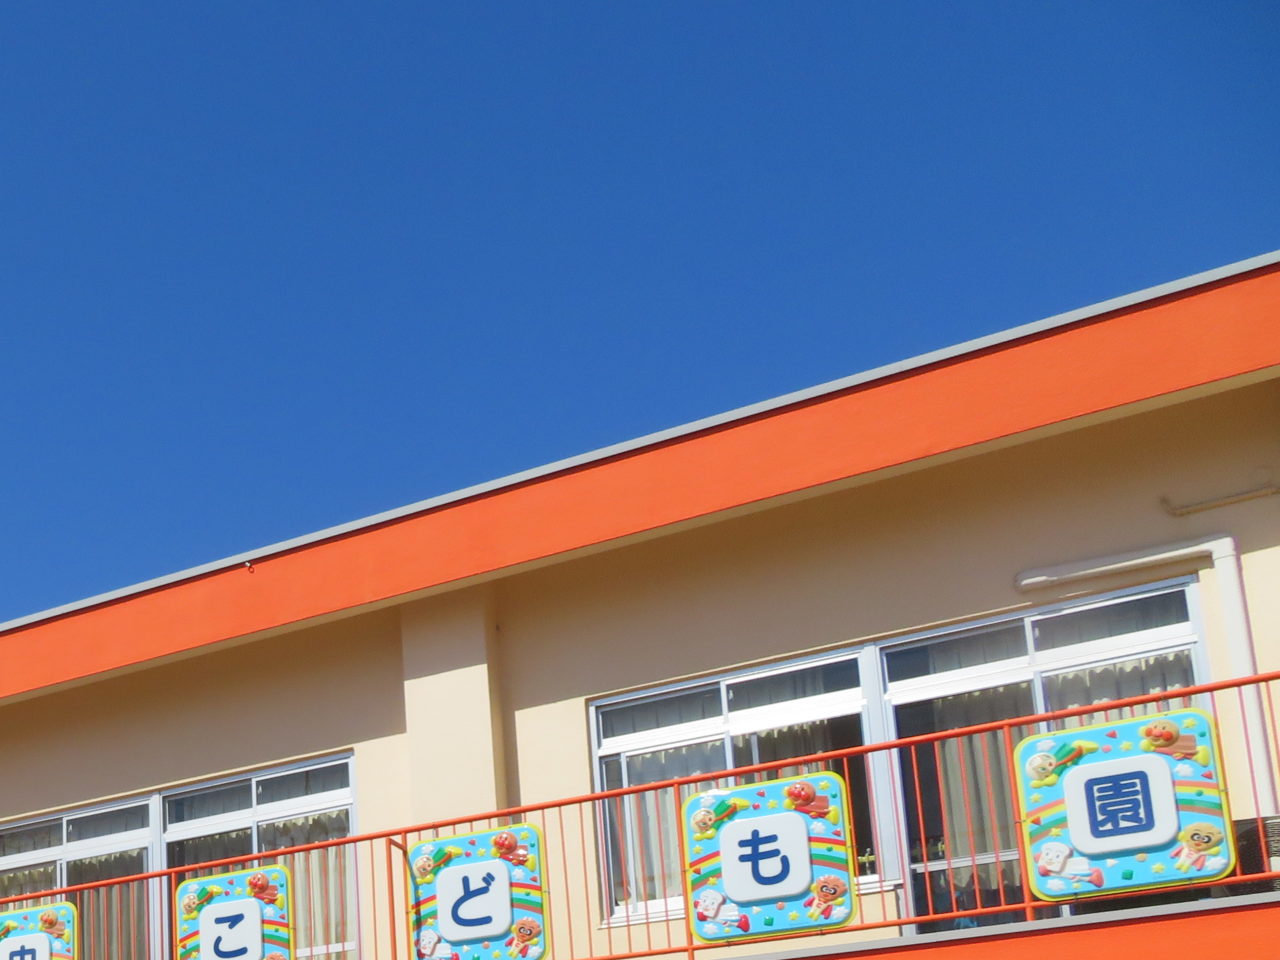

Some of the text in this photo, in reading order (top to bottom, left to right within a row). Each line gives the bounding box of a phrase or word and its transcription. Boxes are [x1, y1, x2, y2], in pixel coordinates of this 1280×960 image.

[213, 913, 248, 959] こ
[451, 872, 496, 927] ど
[737, 829, 790, 886] も
[1084, 770, 1155, 839] 園
